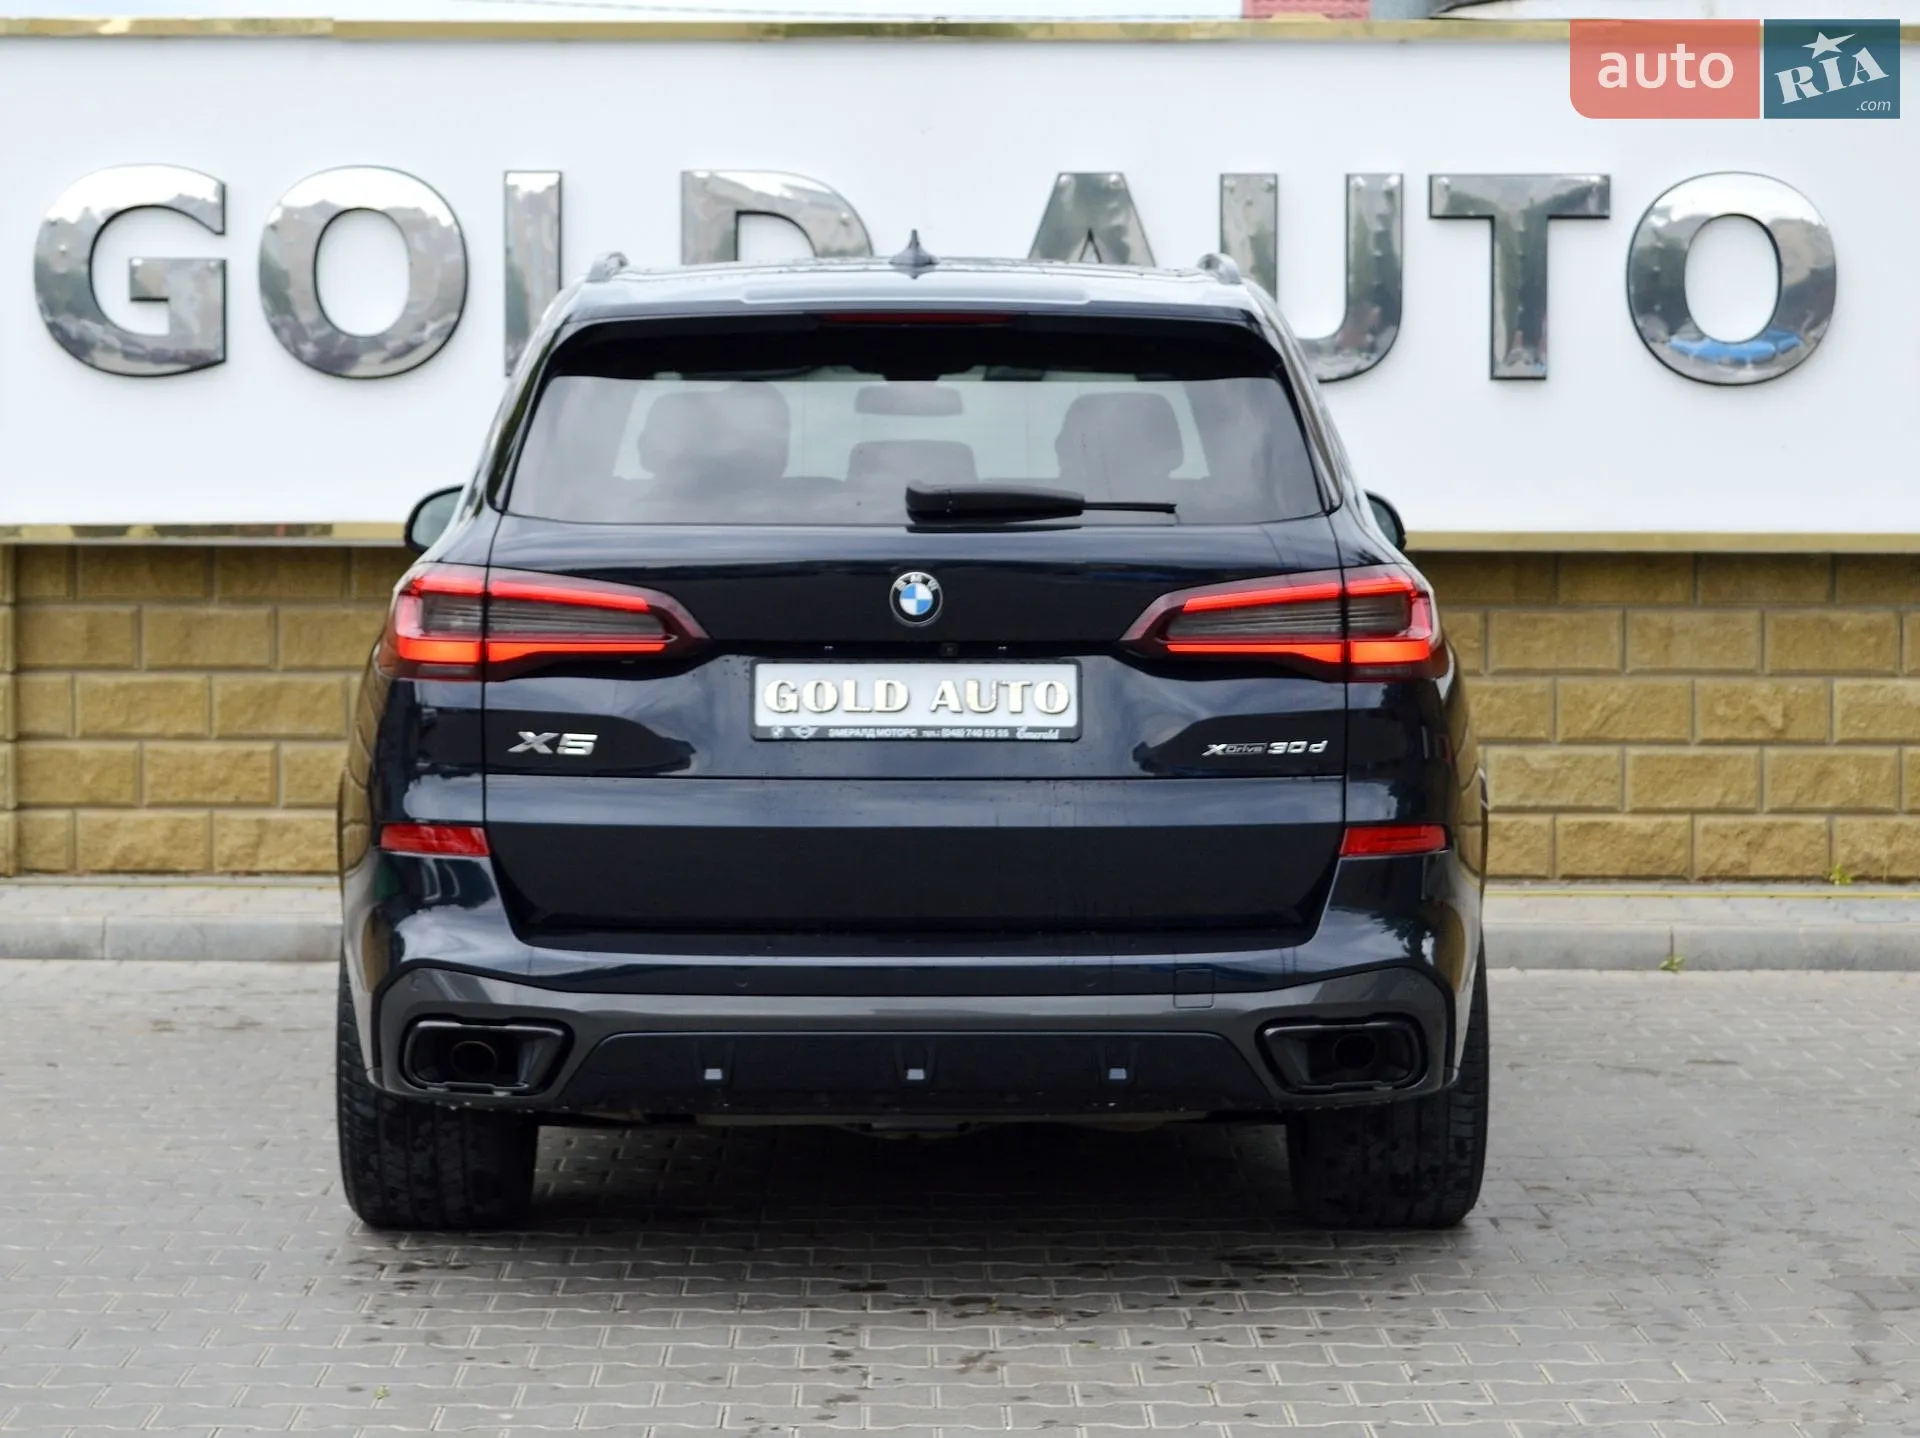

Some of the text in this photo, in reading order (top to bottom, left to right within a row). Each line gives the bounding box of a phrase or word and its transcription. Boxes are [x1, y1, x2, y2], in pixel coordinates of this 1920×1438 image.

[764, 679, 1070, 714] GOLD AUTO
[508, 731, 598, 755] X5
